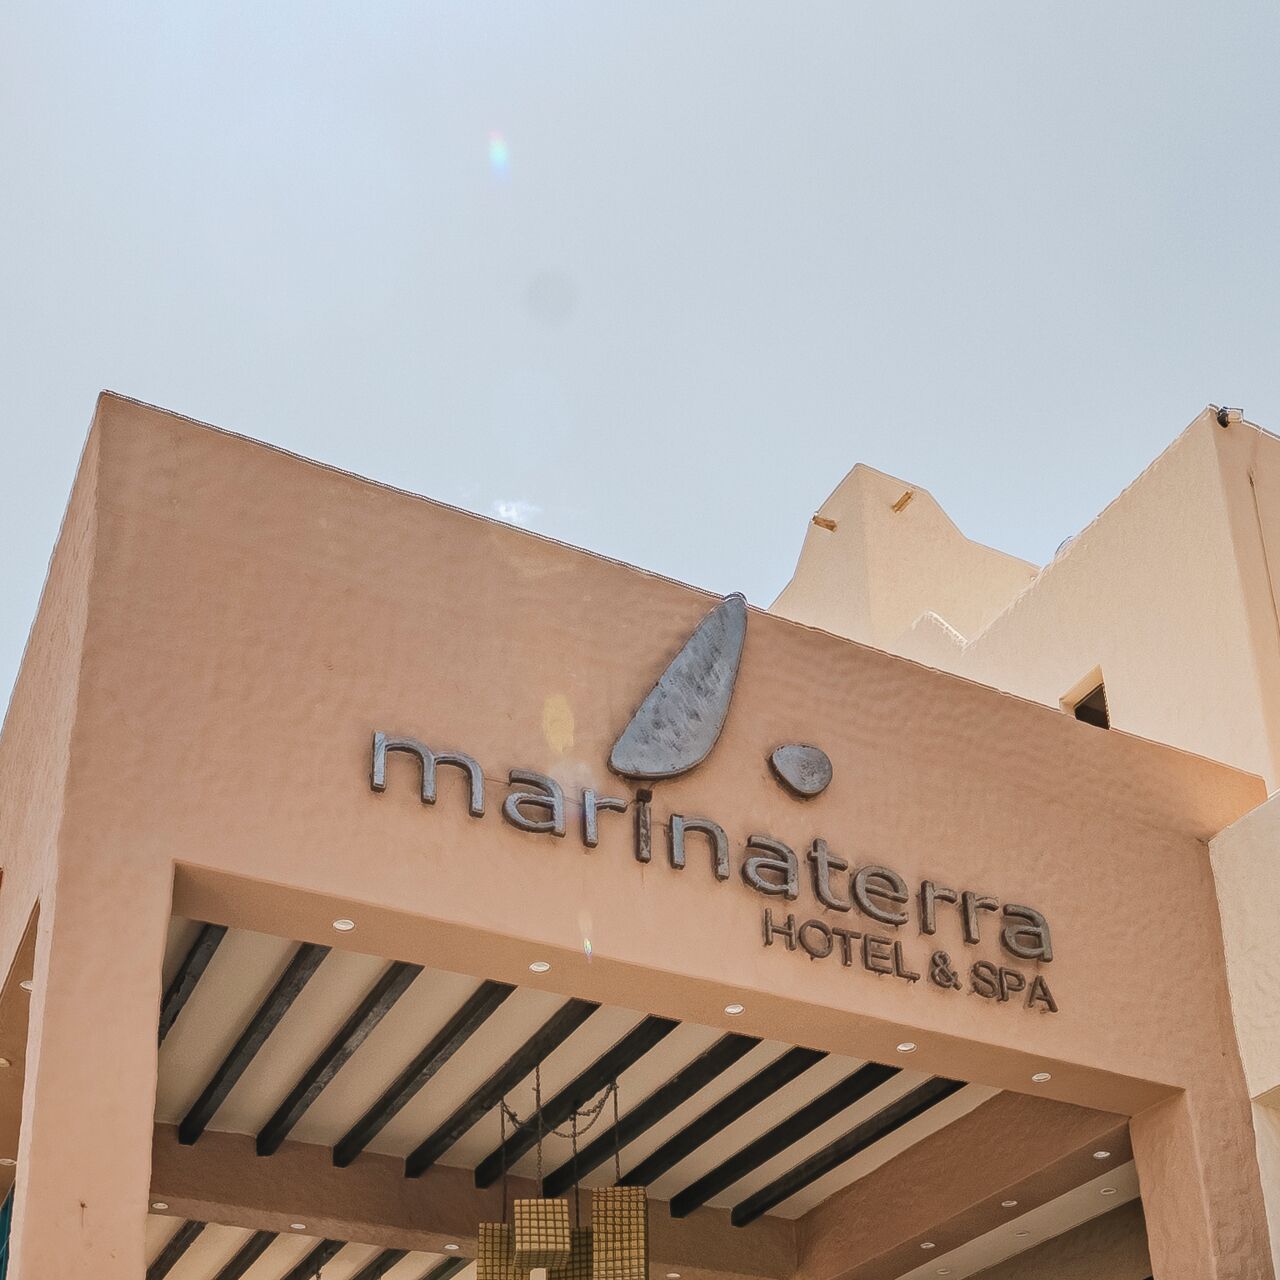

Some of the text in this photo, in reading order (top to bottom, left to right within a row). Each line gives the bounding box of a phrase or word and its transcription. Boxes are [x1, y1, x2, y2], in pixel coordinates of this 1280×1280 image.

[370, 730, 1054, 964] marinaterra
[762, 906, 1060, 1014] HOTEL & SPA
